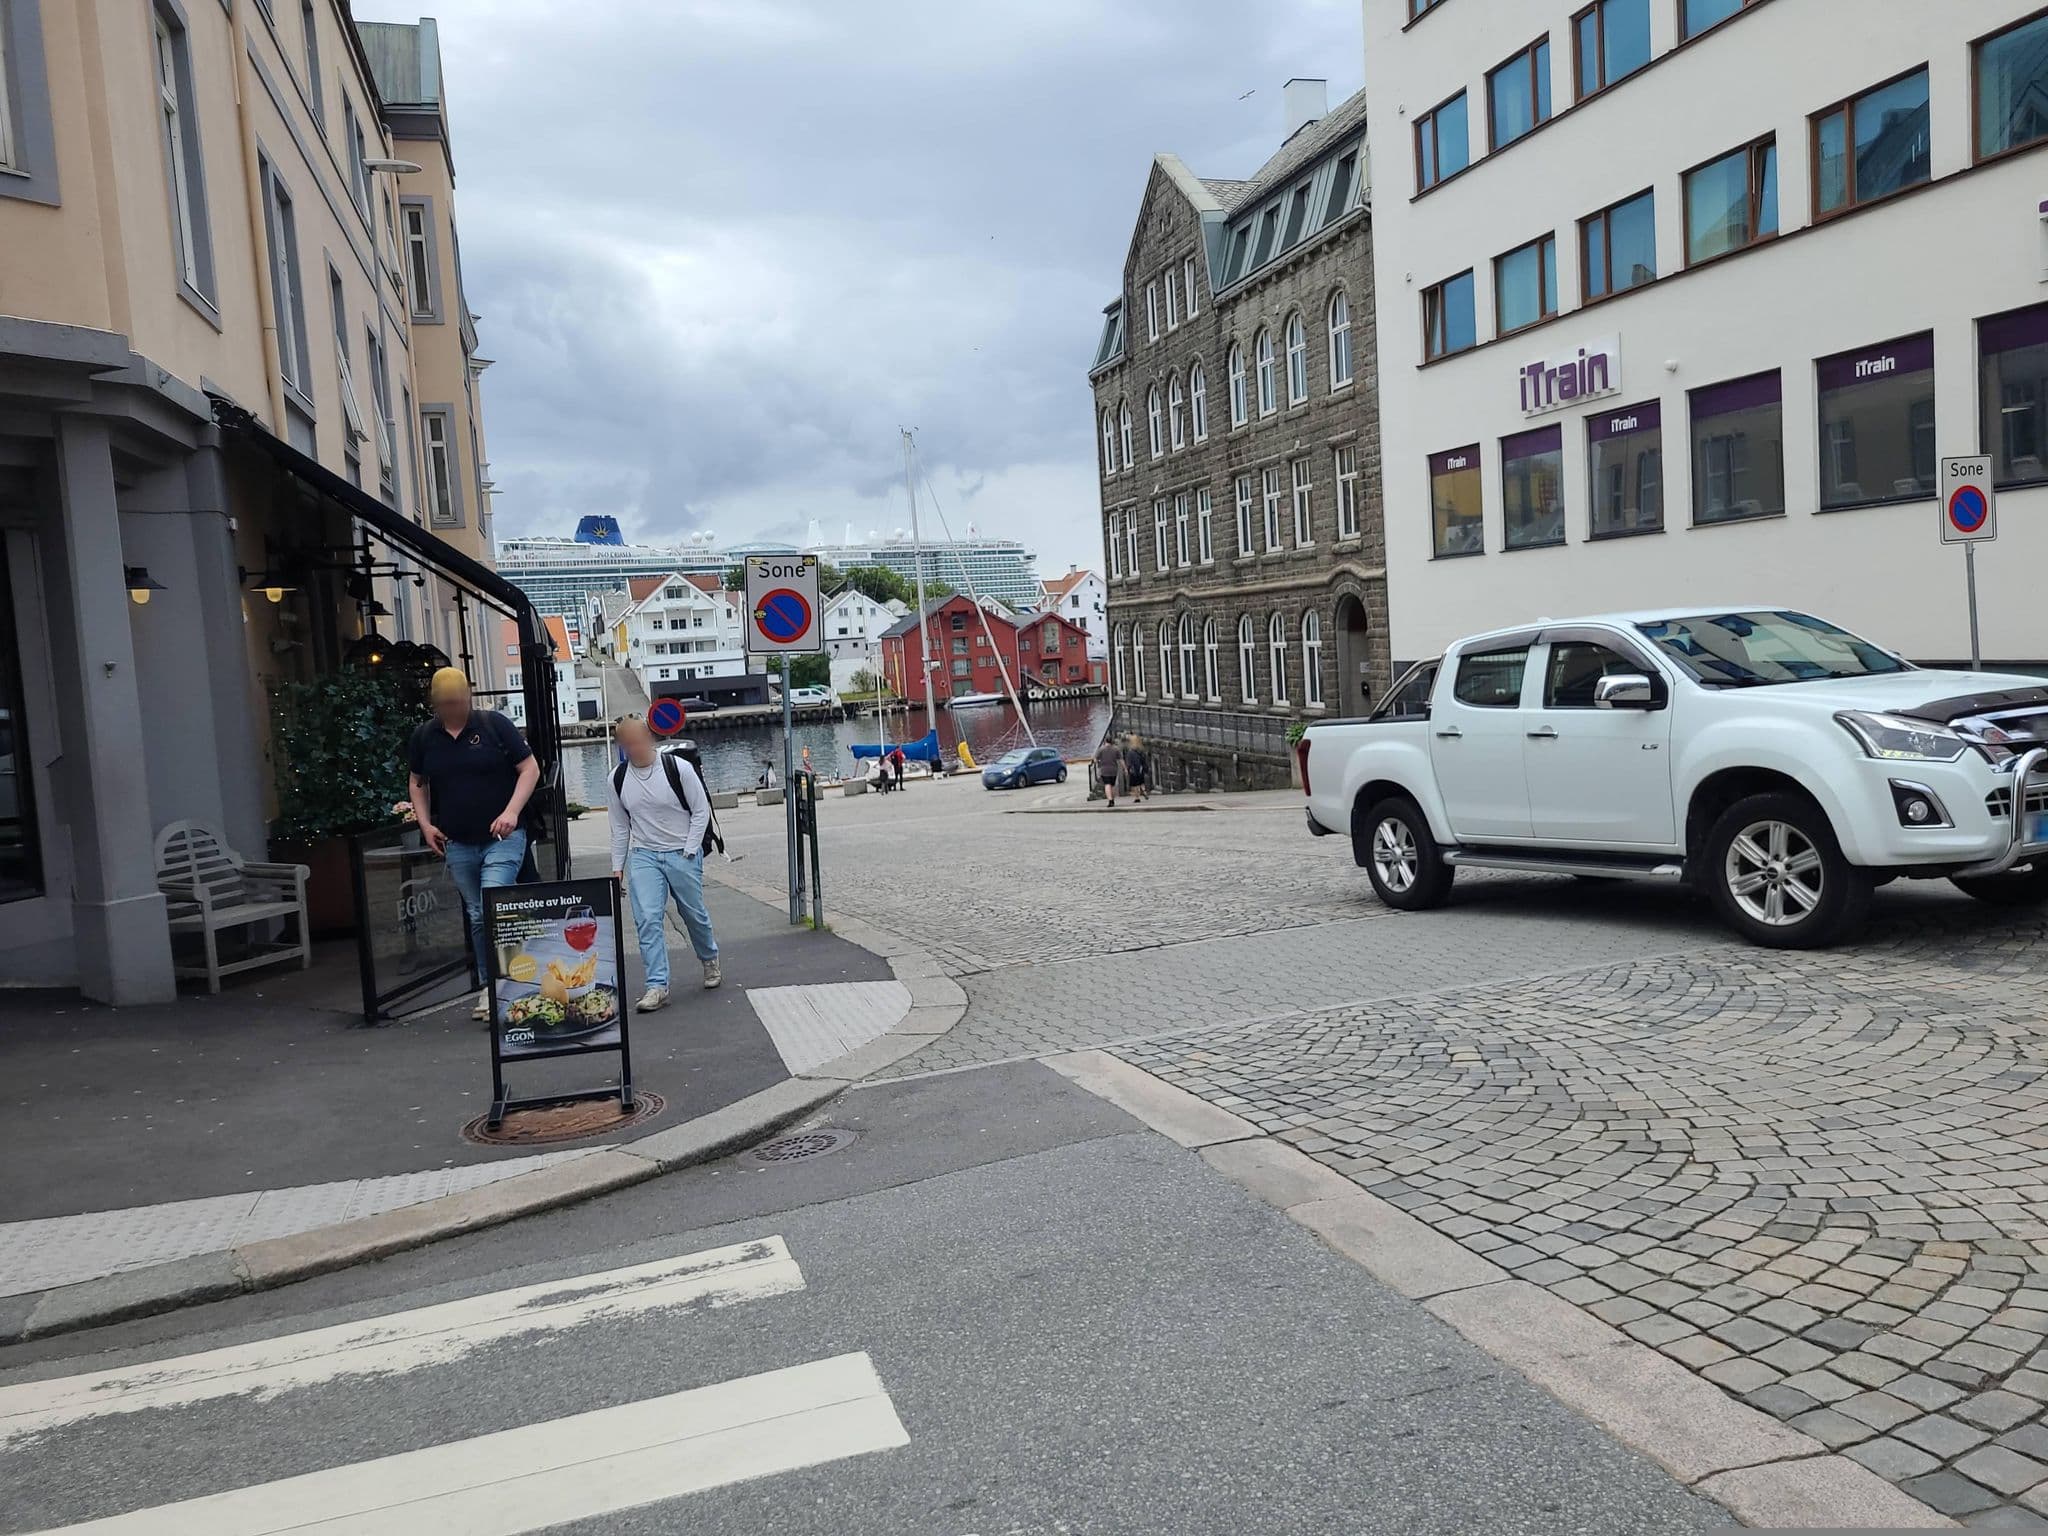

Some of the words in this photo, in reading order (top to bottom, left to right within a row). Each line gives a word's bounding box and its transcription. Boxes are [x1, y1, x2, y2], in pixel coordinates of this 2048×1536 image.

[1855, 355, 1895, 378] iTrain
[1520, 347, 1609, 411] iTrain
[1611, 415, 1638, 433] iTrain
[1447, 455, 1467, 470] iTrain
[1950, 462, 1984, 477] Sone
[758, 561, 806, 578] Sone
[496, 899, 544, 911] Entrecôte
[560, 895, 582, 905] kalv
[504, 1031, 535, 1043] EGON
